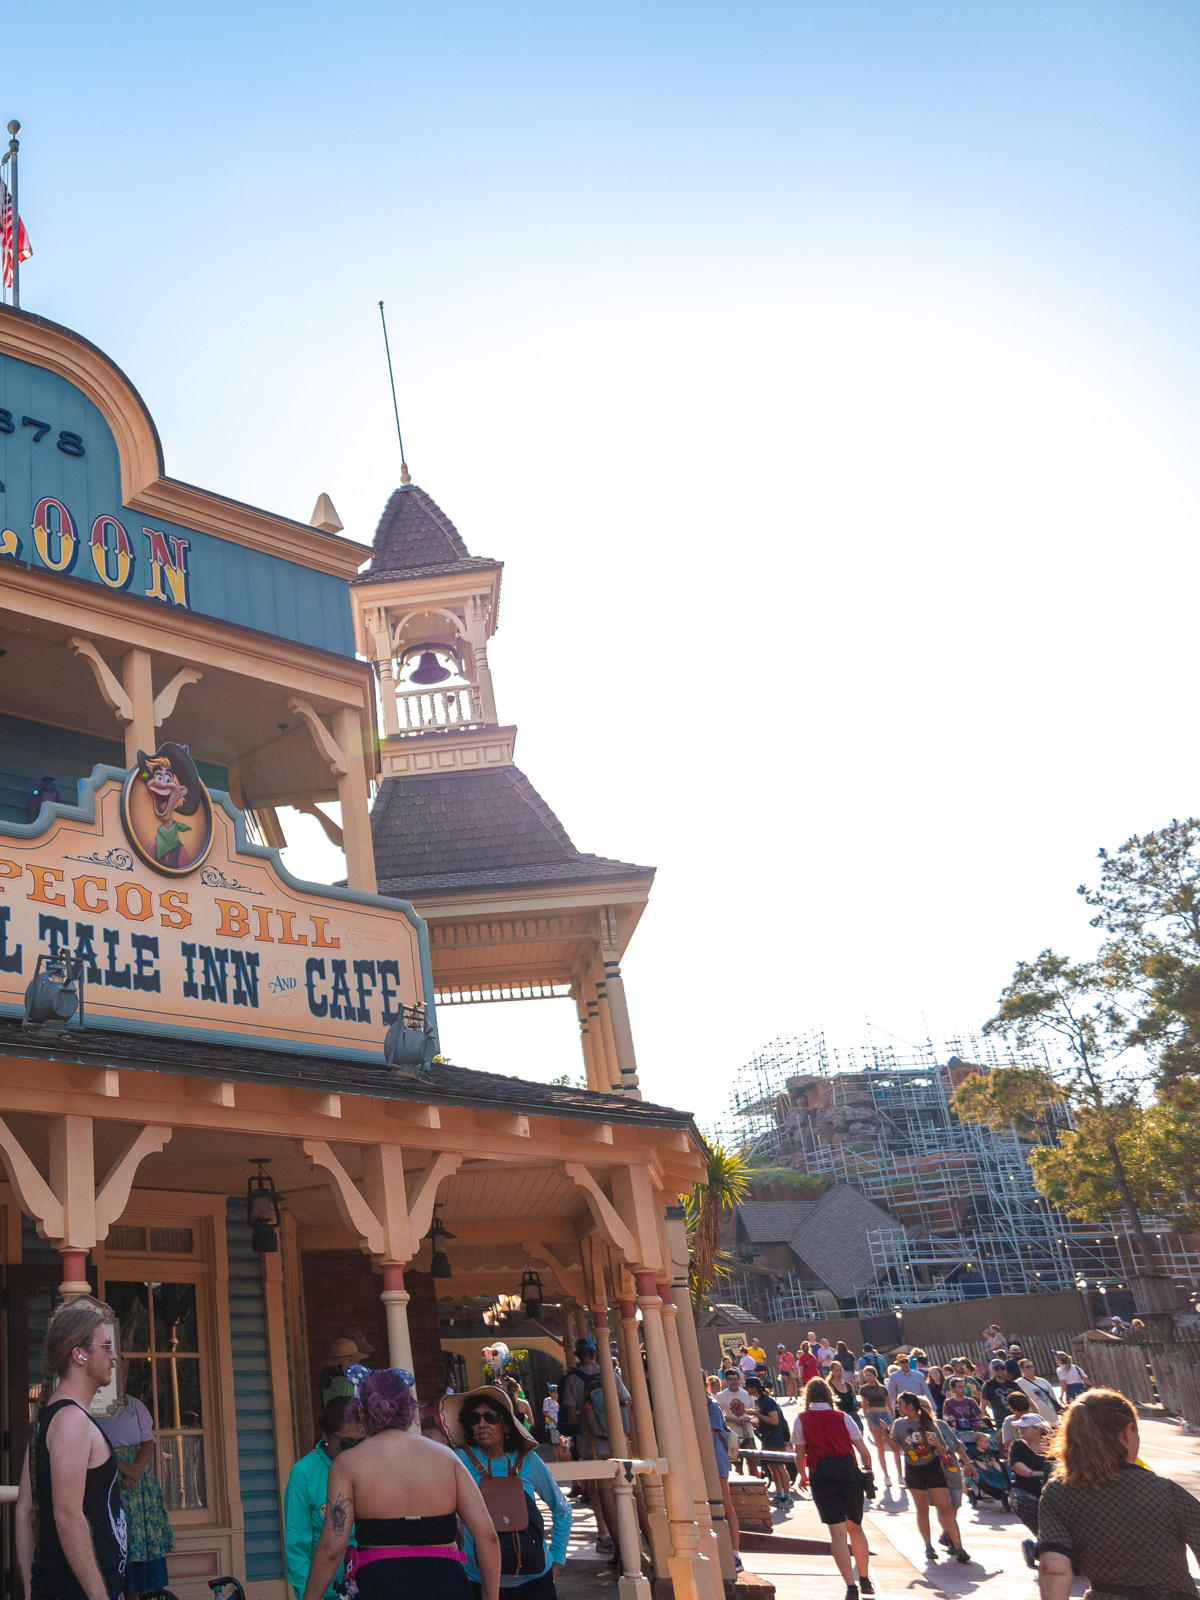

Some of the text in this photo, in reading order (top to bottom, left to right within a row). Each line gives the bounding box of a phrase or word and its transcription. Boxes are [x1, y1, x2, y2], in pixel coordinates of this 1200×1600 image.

[214, 897, 341, 949] BILL
[38, 912, 162, 994] TALE
[181, 941, 261, 1009] INN
[305, 956, 402, 1027] CAFE
